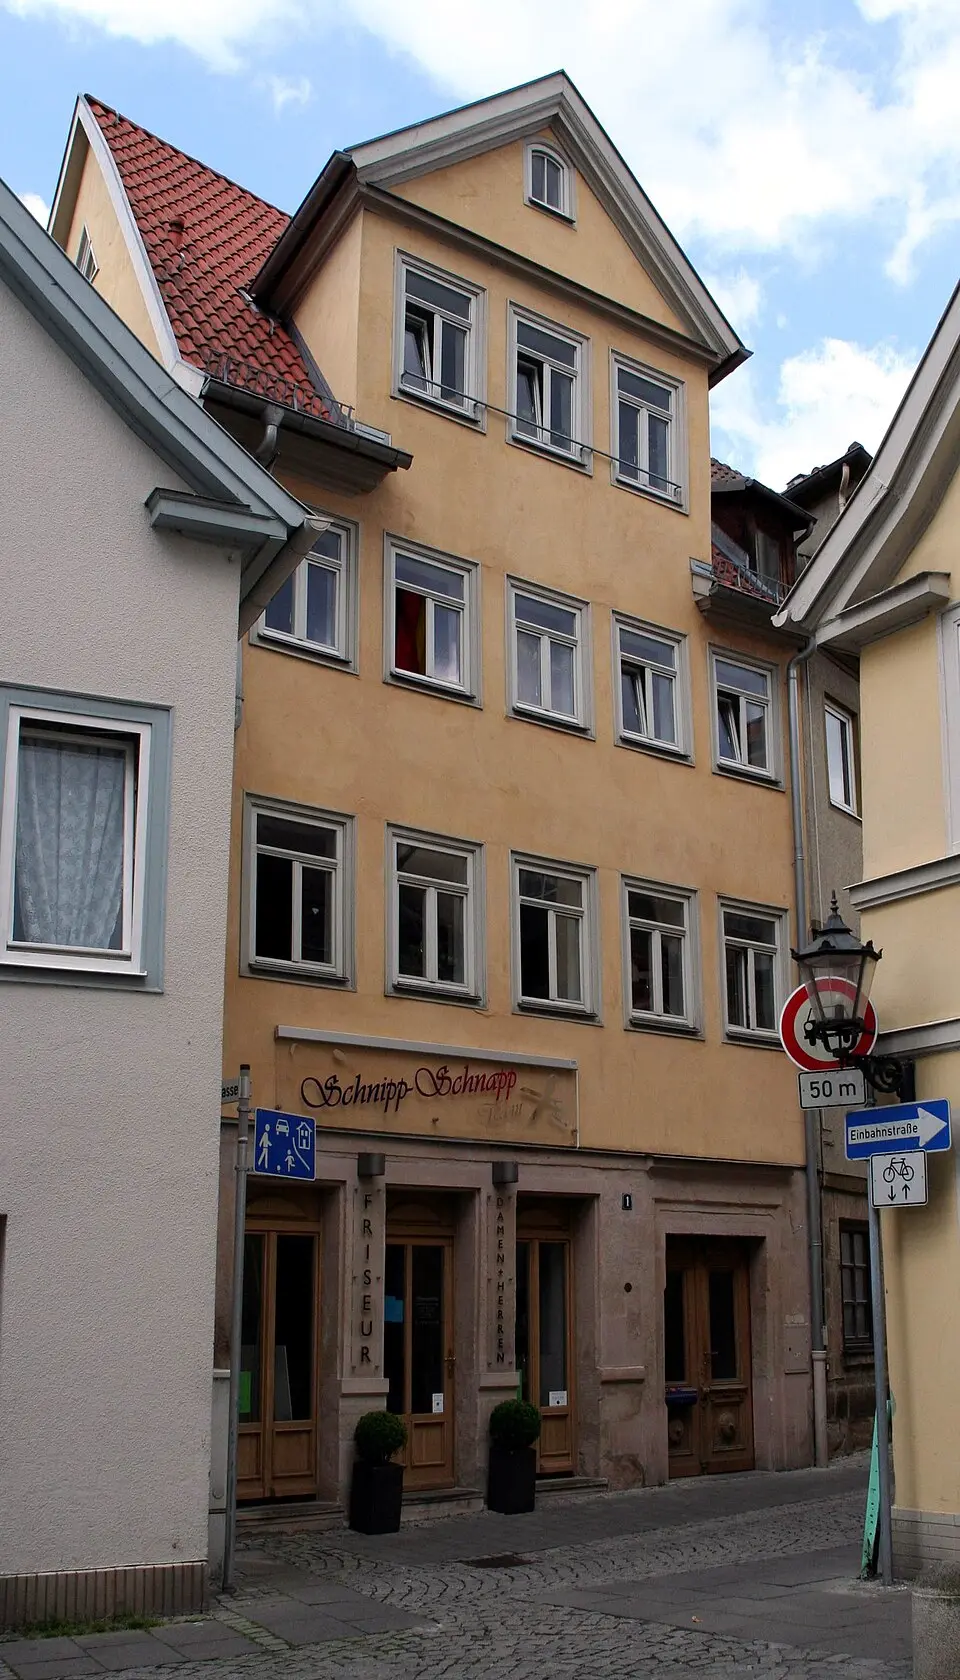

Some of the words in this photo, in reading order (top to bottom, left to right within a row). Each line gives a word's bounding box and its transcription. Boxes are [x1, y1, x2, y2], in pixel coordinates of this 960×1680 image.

[301, 1065, 517, 1112] Schnipp-Schnapp
[810, 1080, 833, 1099] 50
[839, 1082, 856, 1097] m
[850, 1123, 918, 1141] Einbahnstraße
[360, 1193, 373, 1363] FRISEUR
